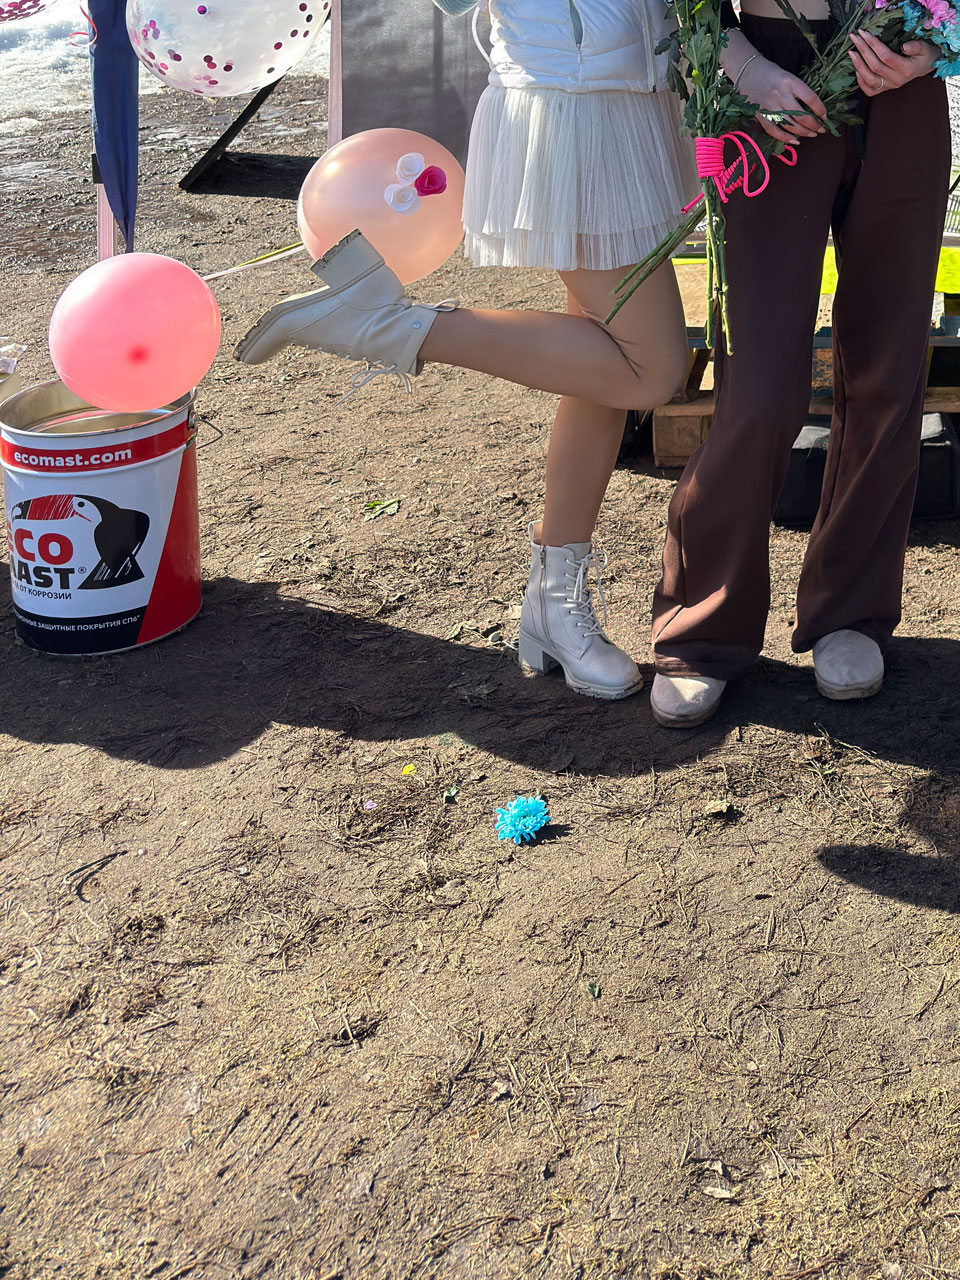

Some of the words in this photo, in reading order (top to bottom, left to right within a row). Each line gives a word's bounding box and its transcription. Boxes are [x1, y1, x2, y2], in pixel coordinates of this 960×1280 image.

[14, 449, 132, 467] ecomast.com
[11, 553, 75, 590] AST
[28, 588, 72, 600] КОРРОЗИИ
[77, 620, 121, 631] ПОКРЫТИЯ
